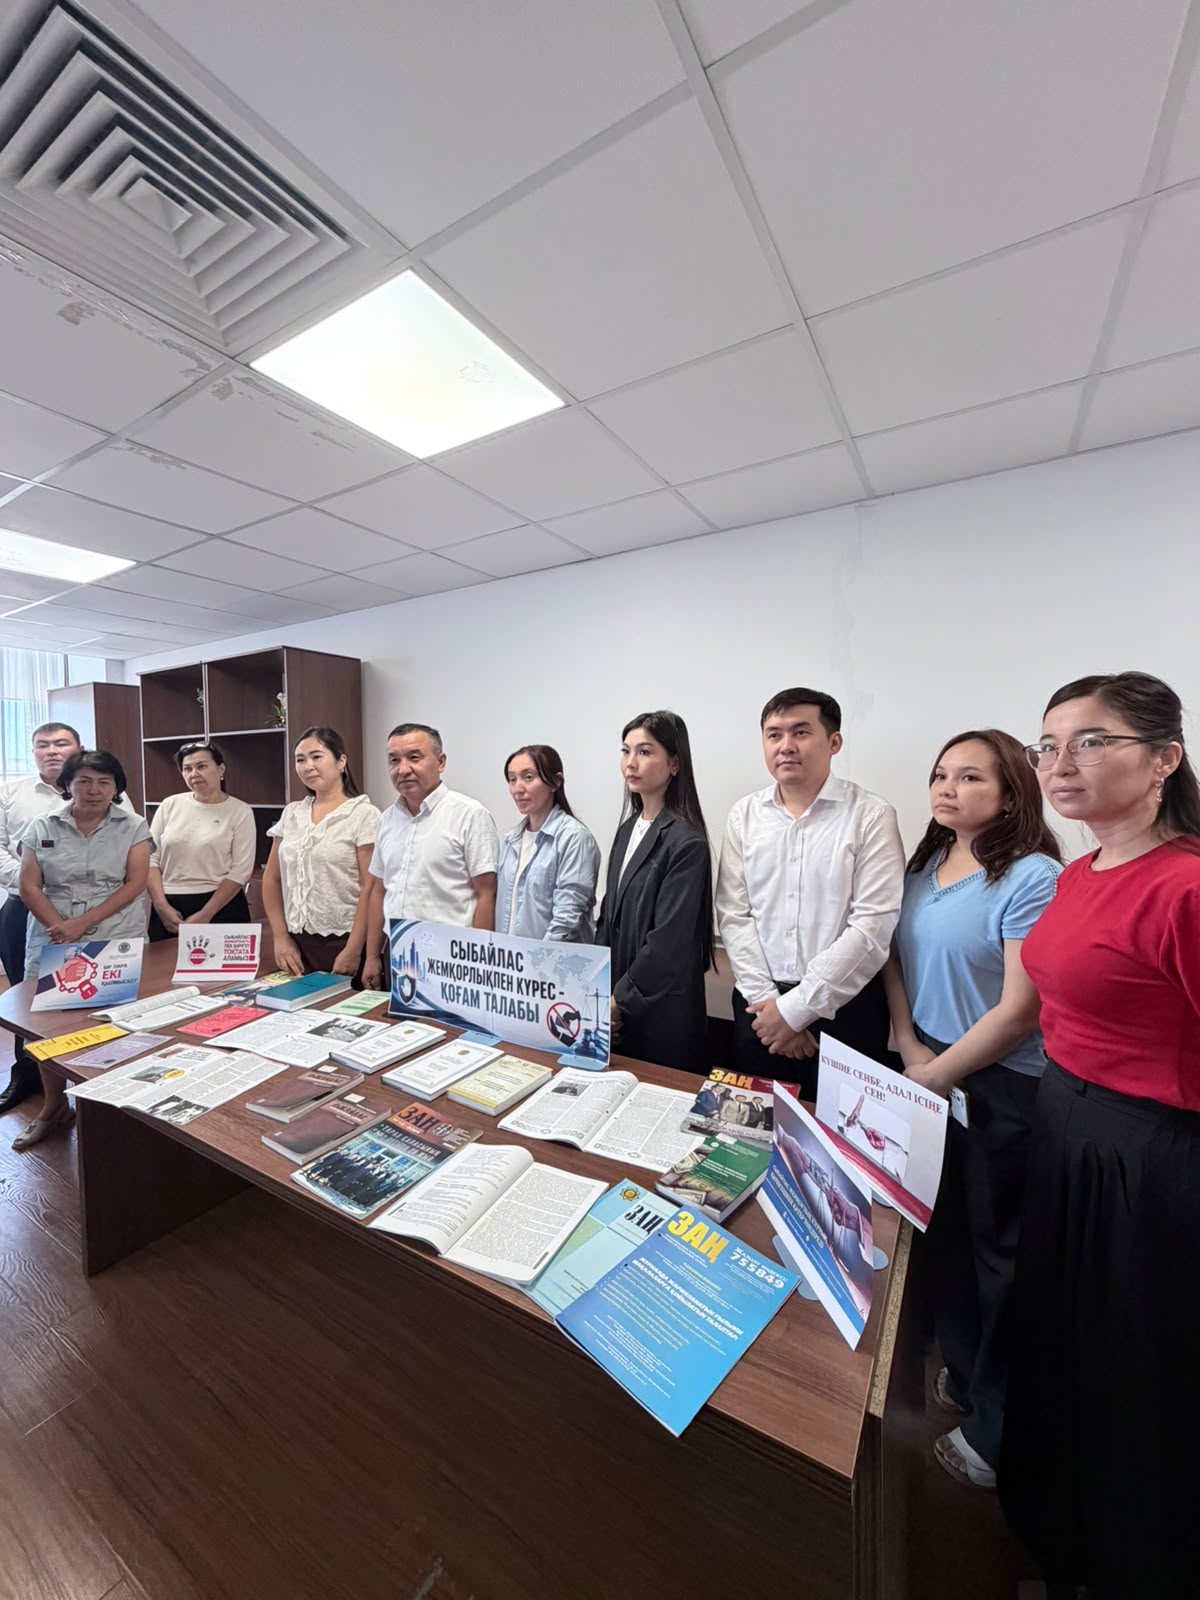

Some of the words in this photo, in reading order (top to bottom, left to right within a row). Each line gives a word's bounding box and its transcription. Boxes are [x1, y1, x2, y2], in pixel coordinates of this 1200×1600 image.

[450, 939, 524, 973] СЫБАЙЛАС
[102, 970, 122, 980] ЕКІ
[427, 957, 514, 993] ЖЕМҚОРЛЫҚПЕН
[517, 977, 556, 1001] КҮРЕС
[441, 981, 480, 1010] ҚОҒАМ
[484, 991, 540, 1024] ТАЛАБЫ
[709, 1068, 754, 1090] ЗАҢ
[864, 1085, 886, 1102] СЕН!
[886, 1083, 912, 1101] АДАЛ
[398, 1106, 442, 1134] ЗАҢ
[667, 1210, 730, 1264] ЗАҢ
[730, 1252, 786, 1289] 755849
